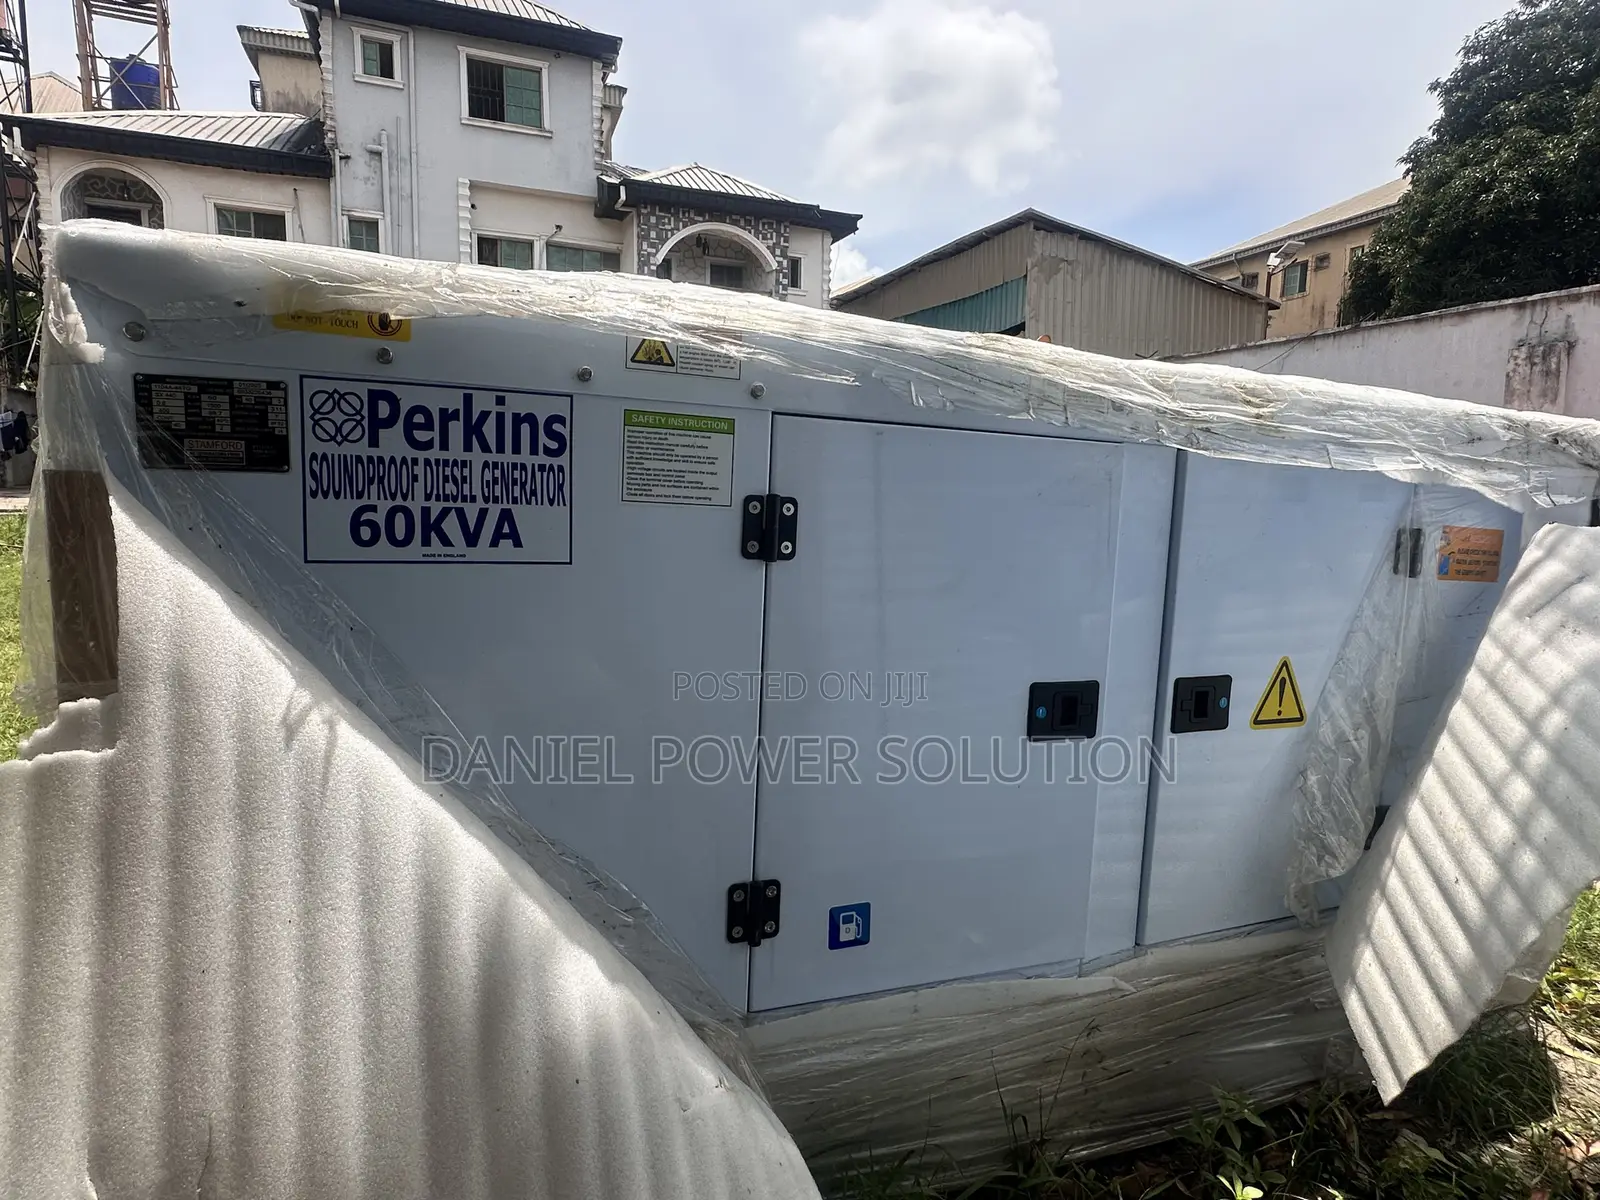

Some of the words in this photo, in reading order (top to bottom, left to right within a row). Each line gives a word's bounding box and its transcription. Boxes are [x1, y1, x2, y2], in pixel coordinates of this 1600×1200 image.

[330, 318, 358, 329] TOUCH
[367, 388, 567, 458] Perkins
[632, 414, 666, 424] SAFETY
[668, 418, 728, 430] INSTRUCTION
[188, 440, 242, 449] STAMFORD
[309, 452, 419, 502] SOUNDPROOF
[424, 457, 477, 504] DIESEL
[480, 460, 567, 507] GENERATOR
[349, 504, 524, 548] 60KVA
